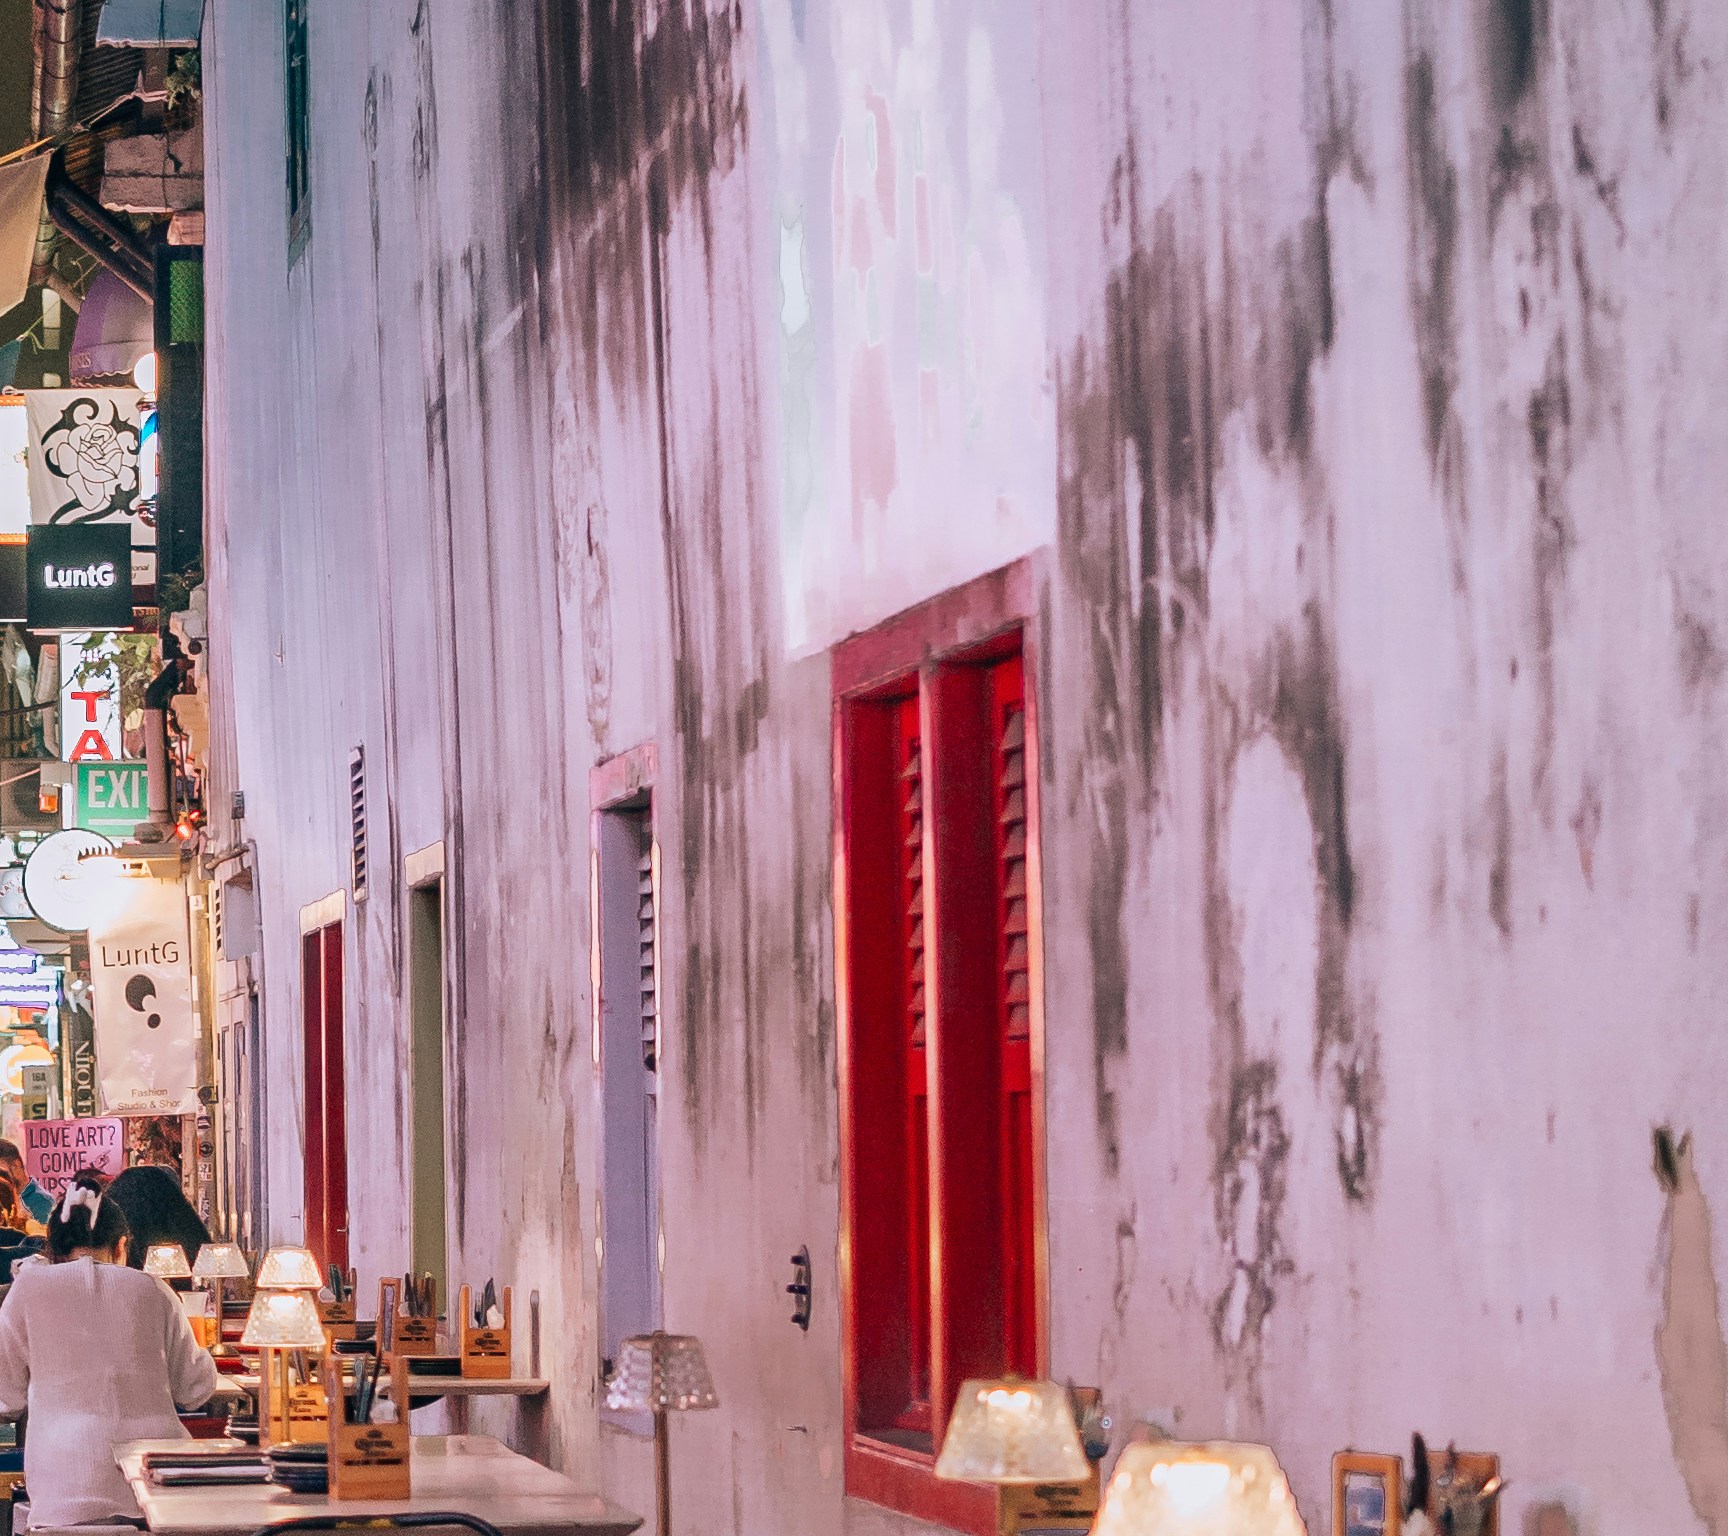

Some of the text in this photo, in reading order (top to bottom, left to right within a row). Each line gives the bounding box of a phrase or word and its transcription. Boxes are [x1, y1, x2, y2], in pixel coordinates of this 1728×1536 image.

[45, 563, 116, 588] LuntG
[102, 941, 179, 967] LuntG
[131, 1088, 168, 1098] Fashion
[117, 1101, 147, 1111] Studio
[149, 1100, 157, 1109] &
[29, 1125, 116, 1149] LOVE ART?
[40, 1151, 88, 1173] COME
